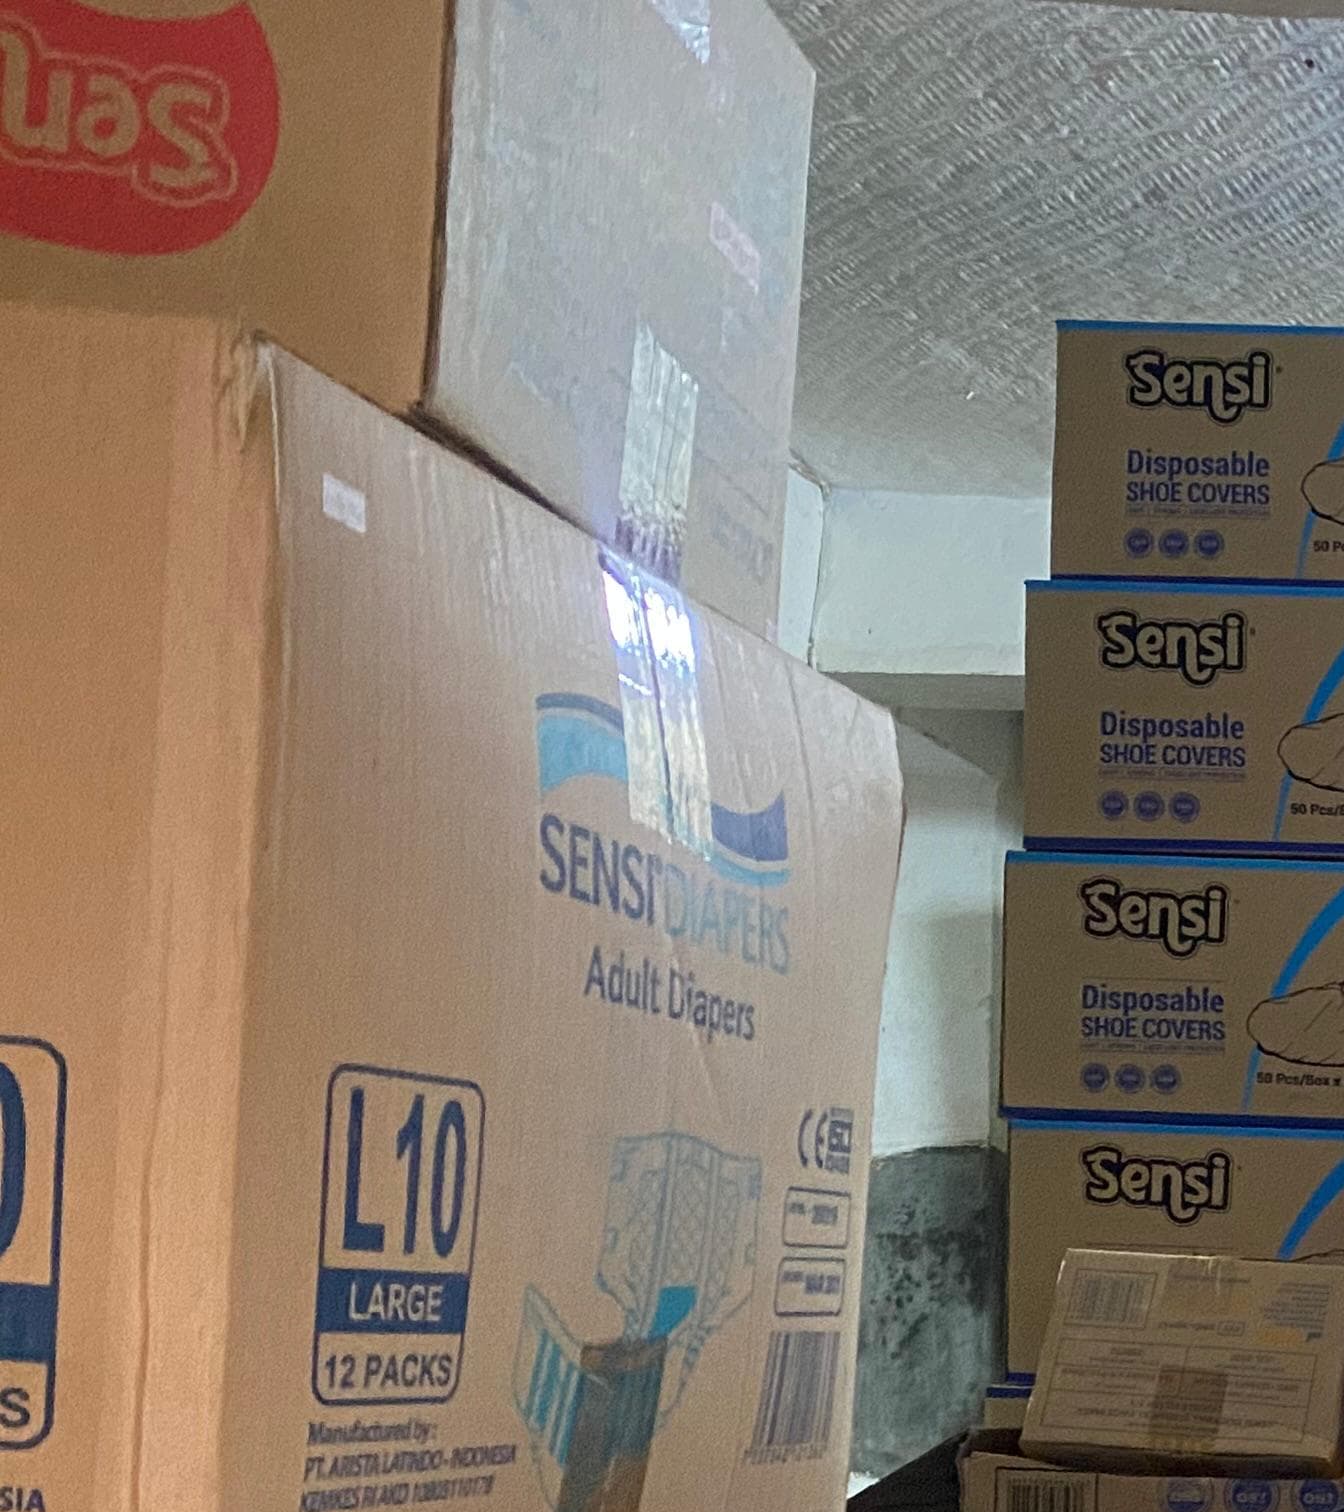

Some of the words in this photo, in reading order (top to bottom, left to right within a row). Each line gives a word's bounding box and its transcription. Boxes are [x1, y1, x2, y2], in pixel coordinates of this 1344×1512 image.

[0, 30, 217, 188] Sen
[1124, 349, 1271, 424] Sensi
[1127, 448, 1270, 482] Disposable
[1126, 482, 1182, 503] SHOE
[1187, 484, 1270, 505] COVERS
[1313, 540, 1330, 553] 50
[1098, 610, 1248, 687] Sensi
[1100, 711, 1245, 743] Disposable
[1100, 744, 1157, 766] SHOE
[1162, 746, 1246, 768] COVERS
[1291, 803, 1307, 817] 50
[540, 813, 655, 928] SENSI
[664, 862, 789, 976] DIAPERS
[1080, 878, 1228, 959] Sensi
[584, 945, 661, 1014] Adult
[668, 966, 755, 1044] Diapers
[1081, 984, 1226, 1015] Disposable
[1081, 1016, 1138, 1038] SHOE
[1142, 1018, 1226, 1041] COVERS
[1081, 1145, 1233, 1225] Sensi
[348, 1281, 444, 1321] LARGE
[323, 1356, 355, 1390] 12
[363, 1352, 452, 1388] PACKS
